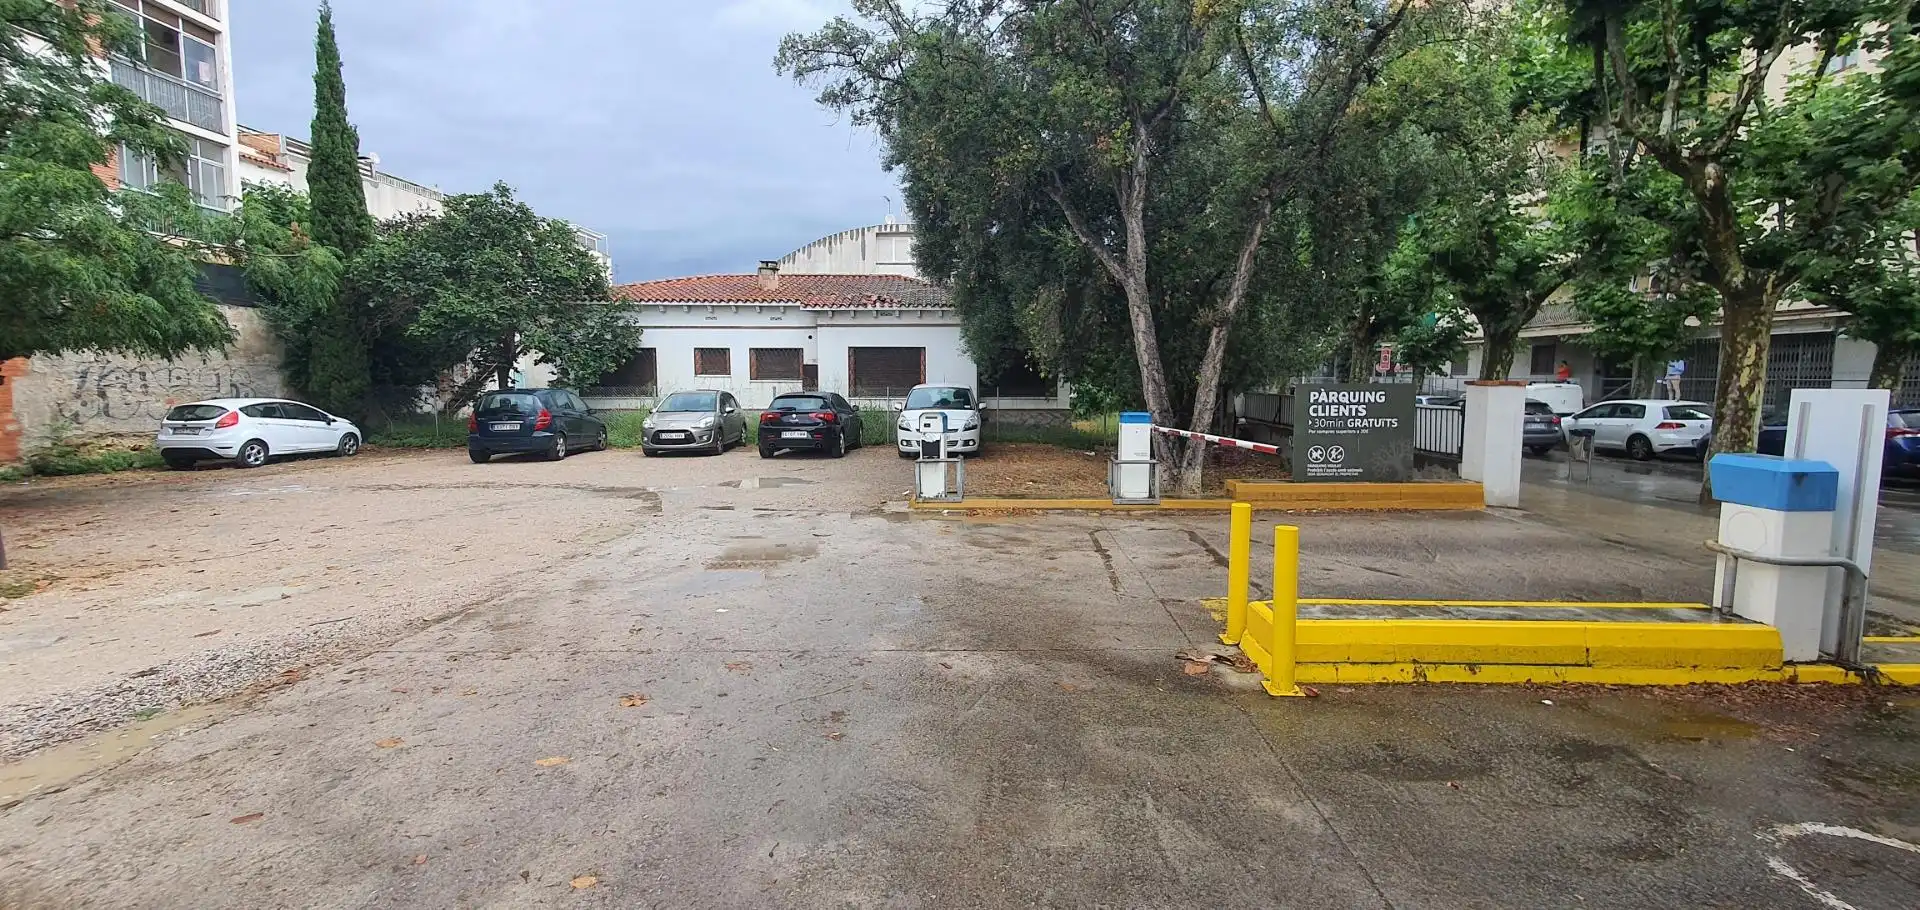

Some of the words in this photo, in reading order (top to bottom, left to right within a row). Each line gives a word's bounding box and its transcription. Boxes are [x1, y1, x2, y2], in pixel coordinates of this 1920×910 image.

[1309, 388, 1386, 404] PÀRQUING
[1308, 404, 1367, 417] CLIENTS
[1313, 418, 1344, 428] 30min
